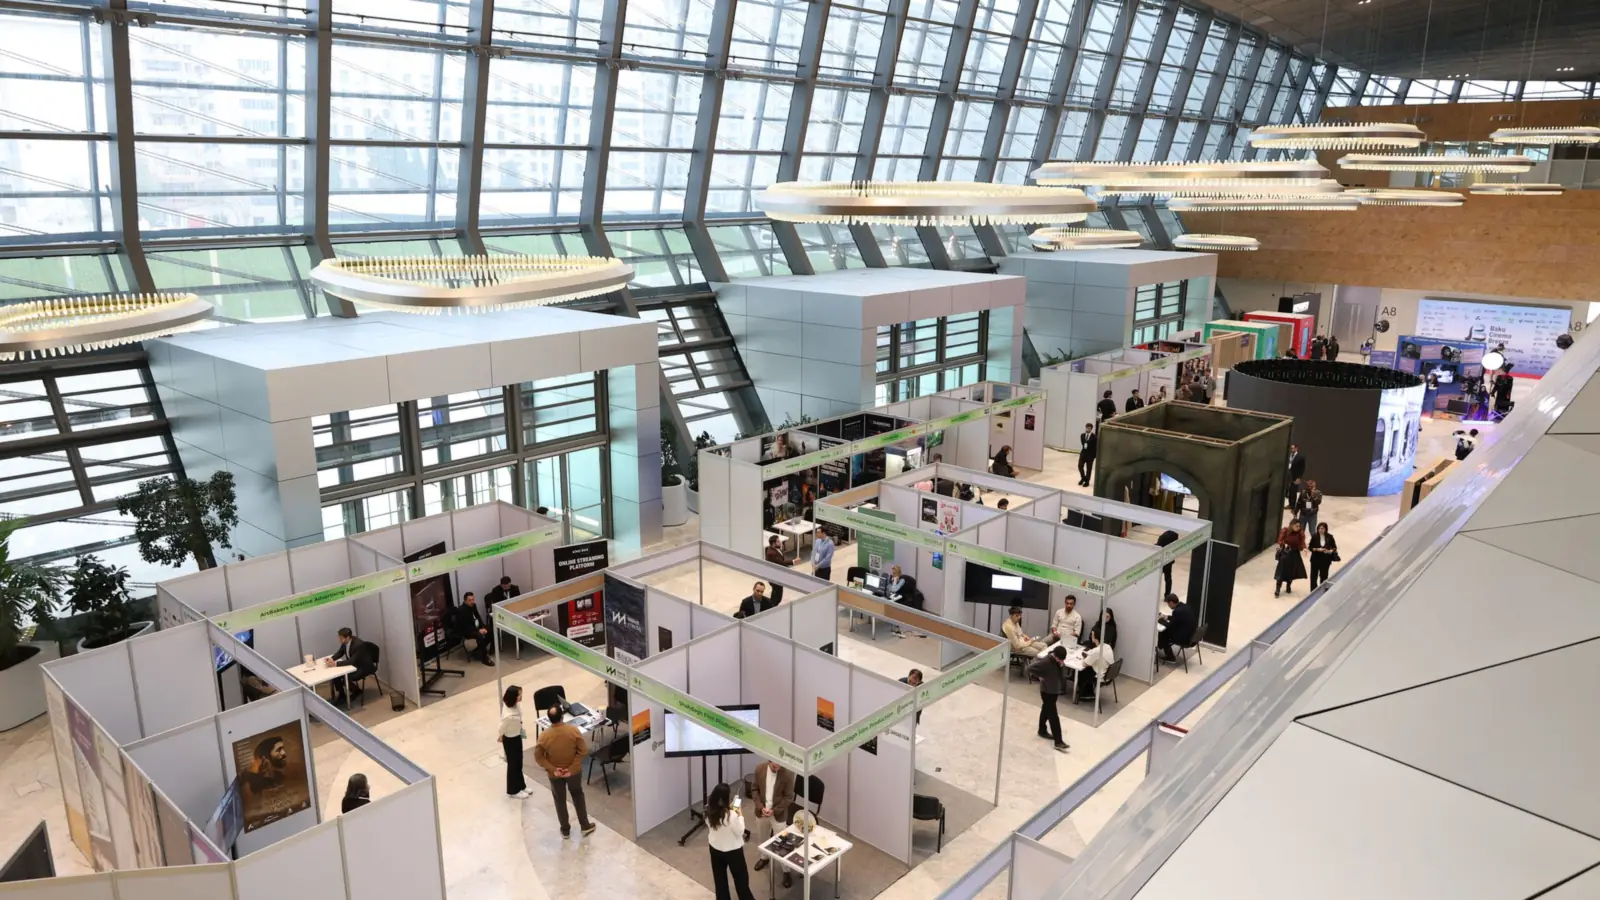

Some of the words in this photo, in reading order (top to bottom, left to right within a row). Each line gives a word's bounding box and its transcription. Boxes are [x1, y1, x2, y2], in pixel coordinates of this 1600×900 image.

[1381, 306, 1397, 317] A8
[1490, 325, 1506, 333] Baku
[558, 559, 576, 567] ONLINE
[577, 554, 604, 564] STREAMING
[569, 561, 595, 570] PLATFORM
[290, 598, 313, 610] Creative
[314, 590, 345, 602] Advertising
[346, 583, 366, 594] Agency
[869, 711, 894, 728] Production
[715, 717, 745, 736] Production
